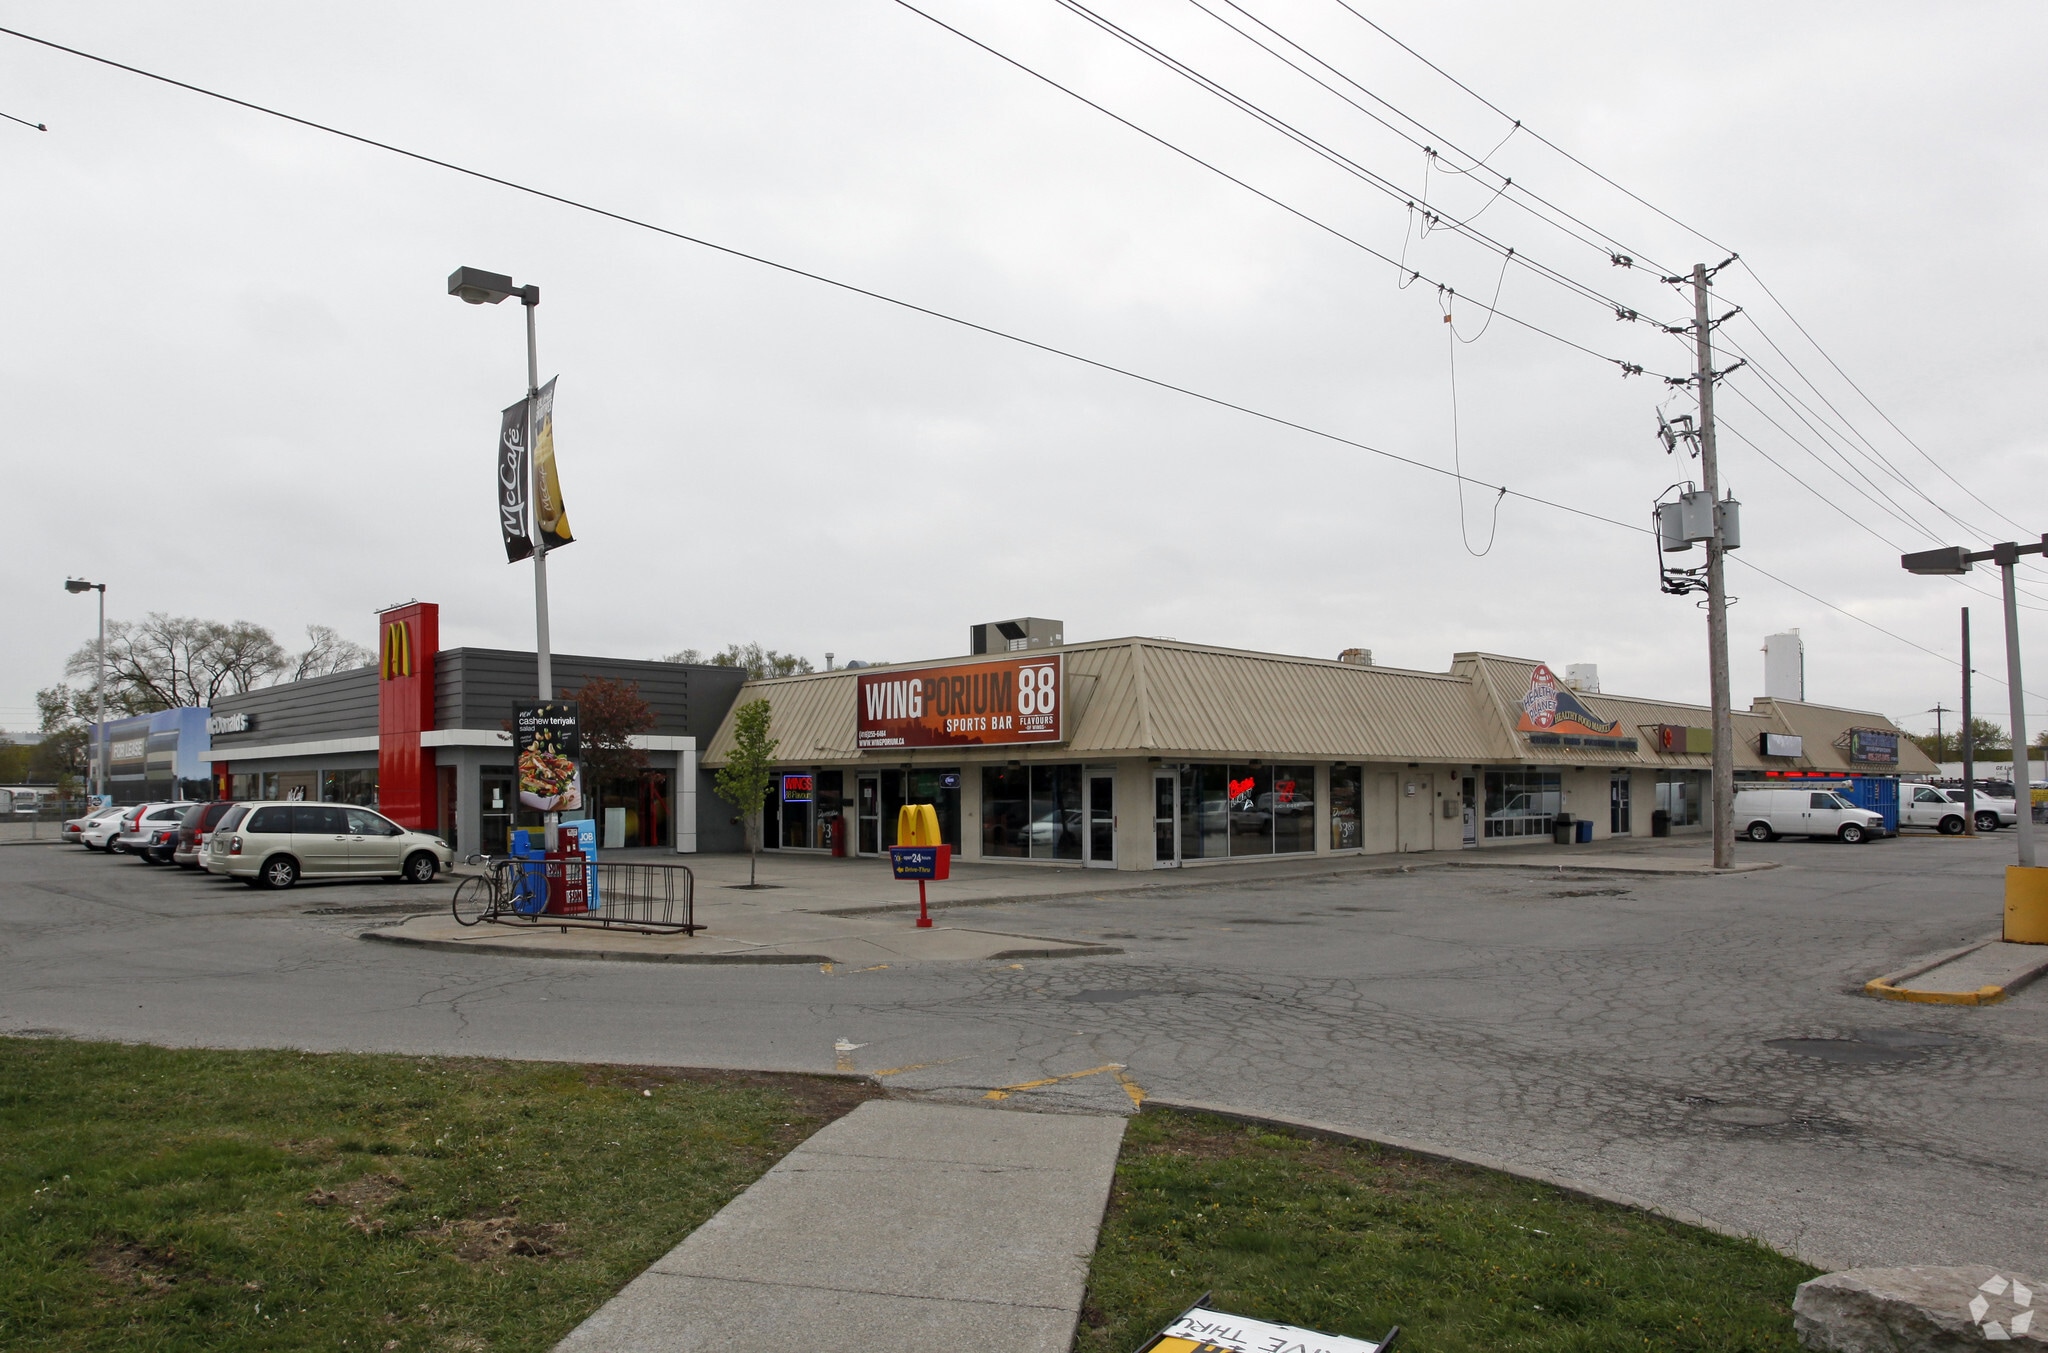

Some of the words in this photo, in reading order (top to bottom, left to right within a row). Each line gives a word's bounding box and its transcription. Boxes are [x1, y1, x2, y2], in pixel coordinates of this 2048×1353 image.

[501, 428, 524, 538] McCafé
[1018, 666, 1055, 715] 88
[1523, 685, 1557, 710] HEALTHY
[1529, 700, 1558, 720] PLANET
[206, 713, 248, 735] McDonald's
[518, 717, 549, 725] cashew
[550, 716, 576, 727] teriyaki
[946, 717, 987, 733] SPORTS
[991, 715, 1013, 730] BAR
[1020, 716, 1054, 726] FLAVOURS
[1554, 711, 1577, 724] HEALTHY
[1578, 715, 1592, 729] FOOD
[1592, 721, 1610, 732] MARKET
[125, 741, 143, 757] LEASE
[786, 777, 813, 791] WINGS
[580, 832, 594, 841] JOB
[911, 853, 922, 863] 24
[1182, 1317, 1248, 1345] THRU
